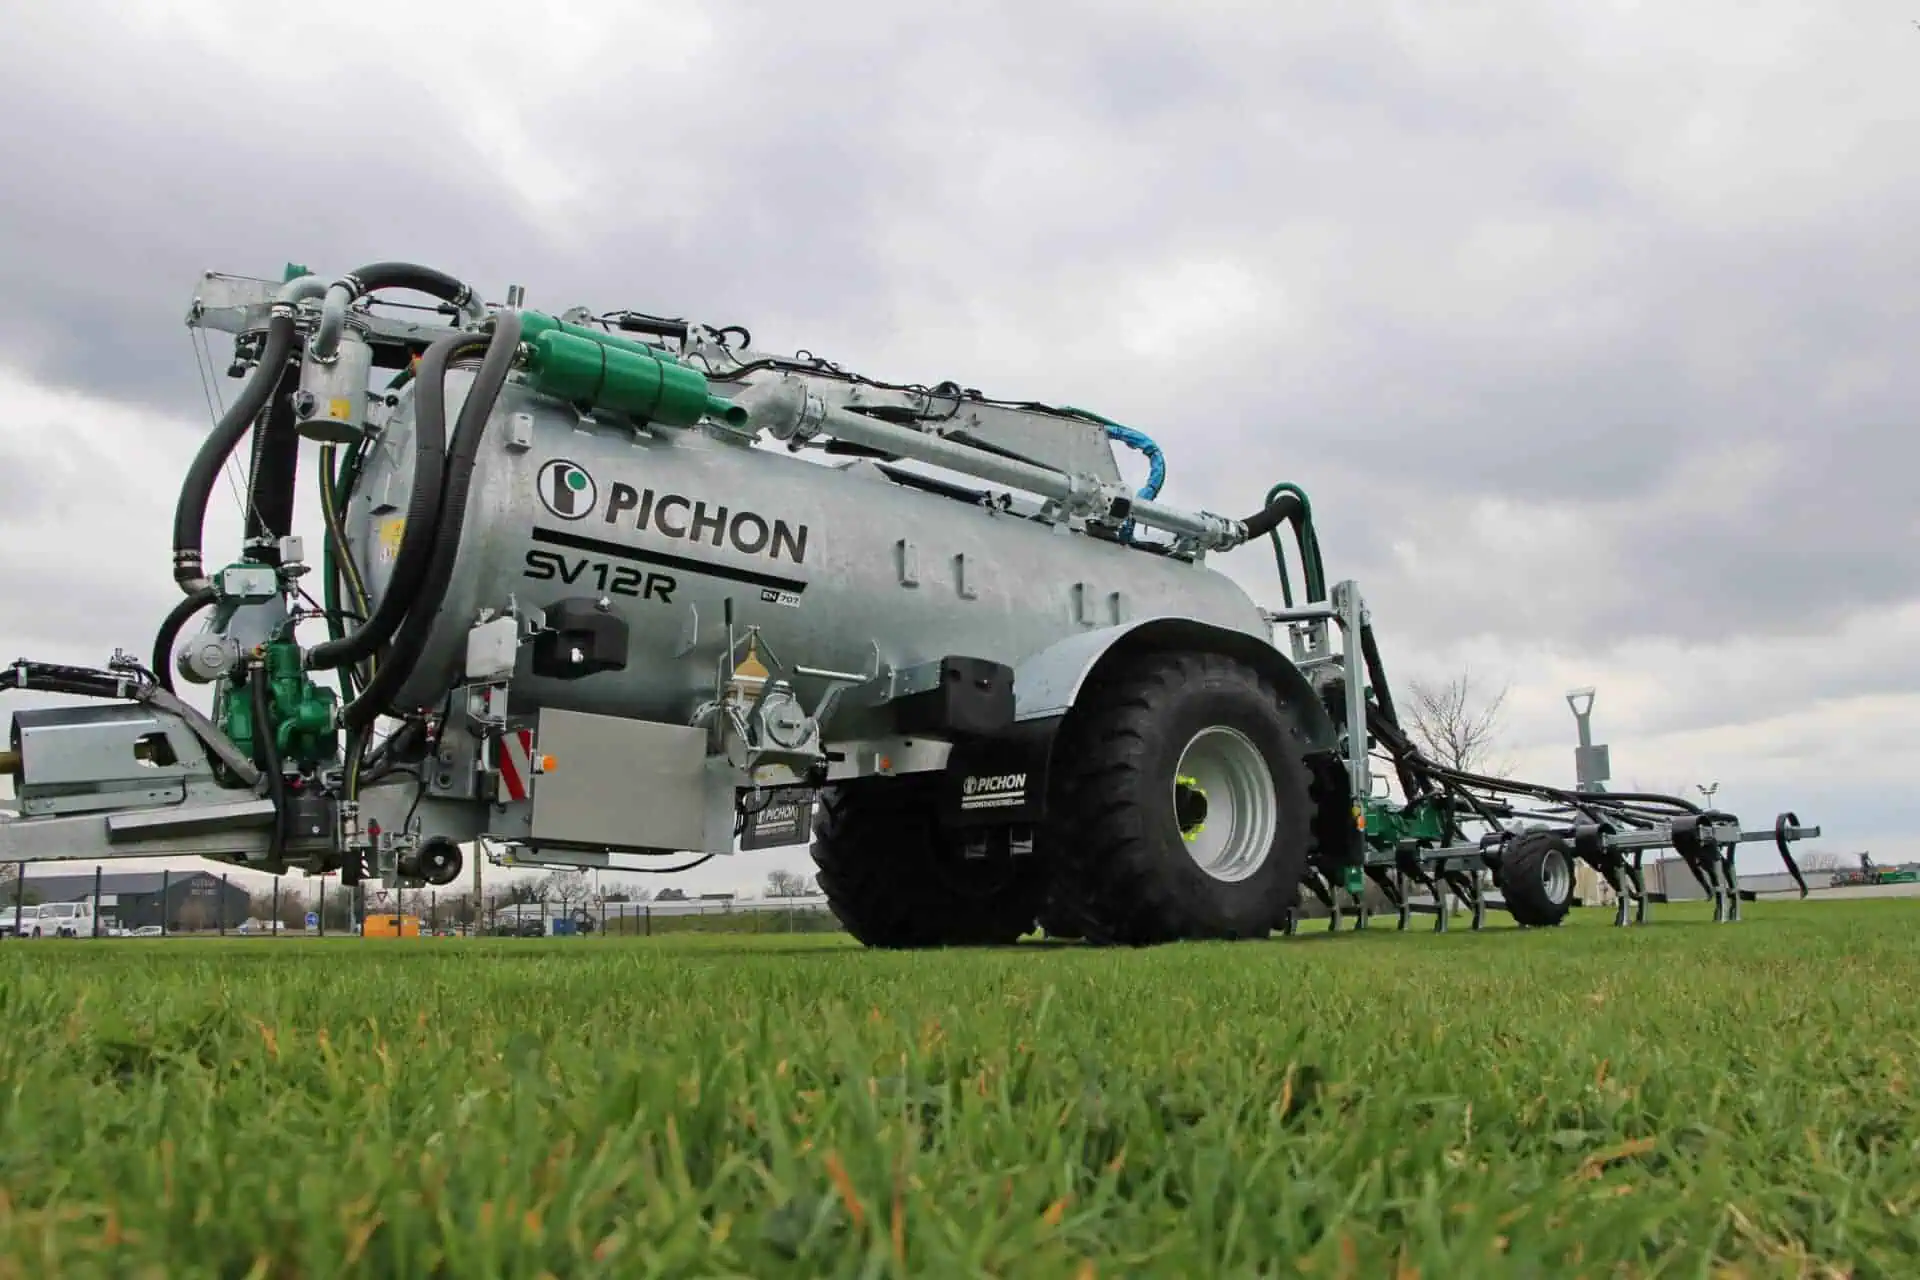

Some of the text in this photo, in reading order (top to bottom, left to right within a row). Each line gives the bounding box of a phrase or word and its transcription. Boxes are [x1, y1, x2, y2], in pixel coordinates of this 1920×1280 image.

[605, 481, 808, 564] PICHON
[523, 549, 677, 604] SV12R
[977, 773, 1026, 792] PICHON
